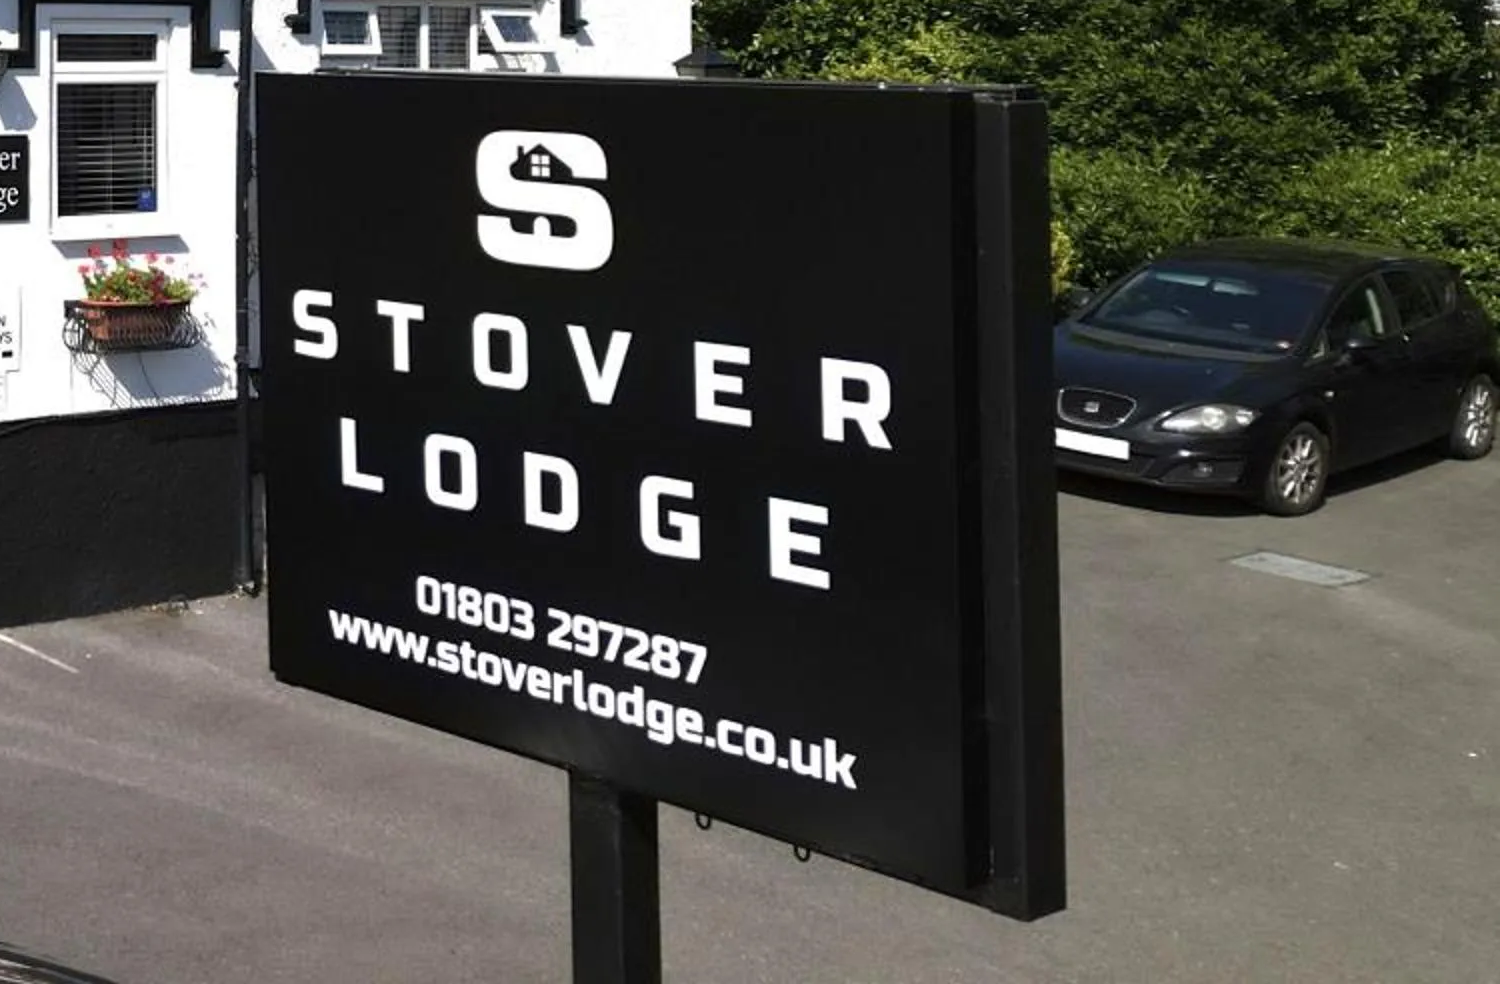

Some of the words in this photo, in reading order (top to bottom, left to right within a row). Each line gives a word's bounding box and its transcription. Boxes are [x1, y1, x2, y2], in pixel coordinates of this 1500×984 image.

[292, 289, 893, 450] STOVER
[340, 417, 831, 590] LODGE
[328, 609, 858, 790] www.stoverlodge.co.uk
[415, 575, 535, 641] 01803
[547, 607, 707, 684] 297287
